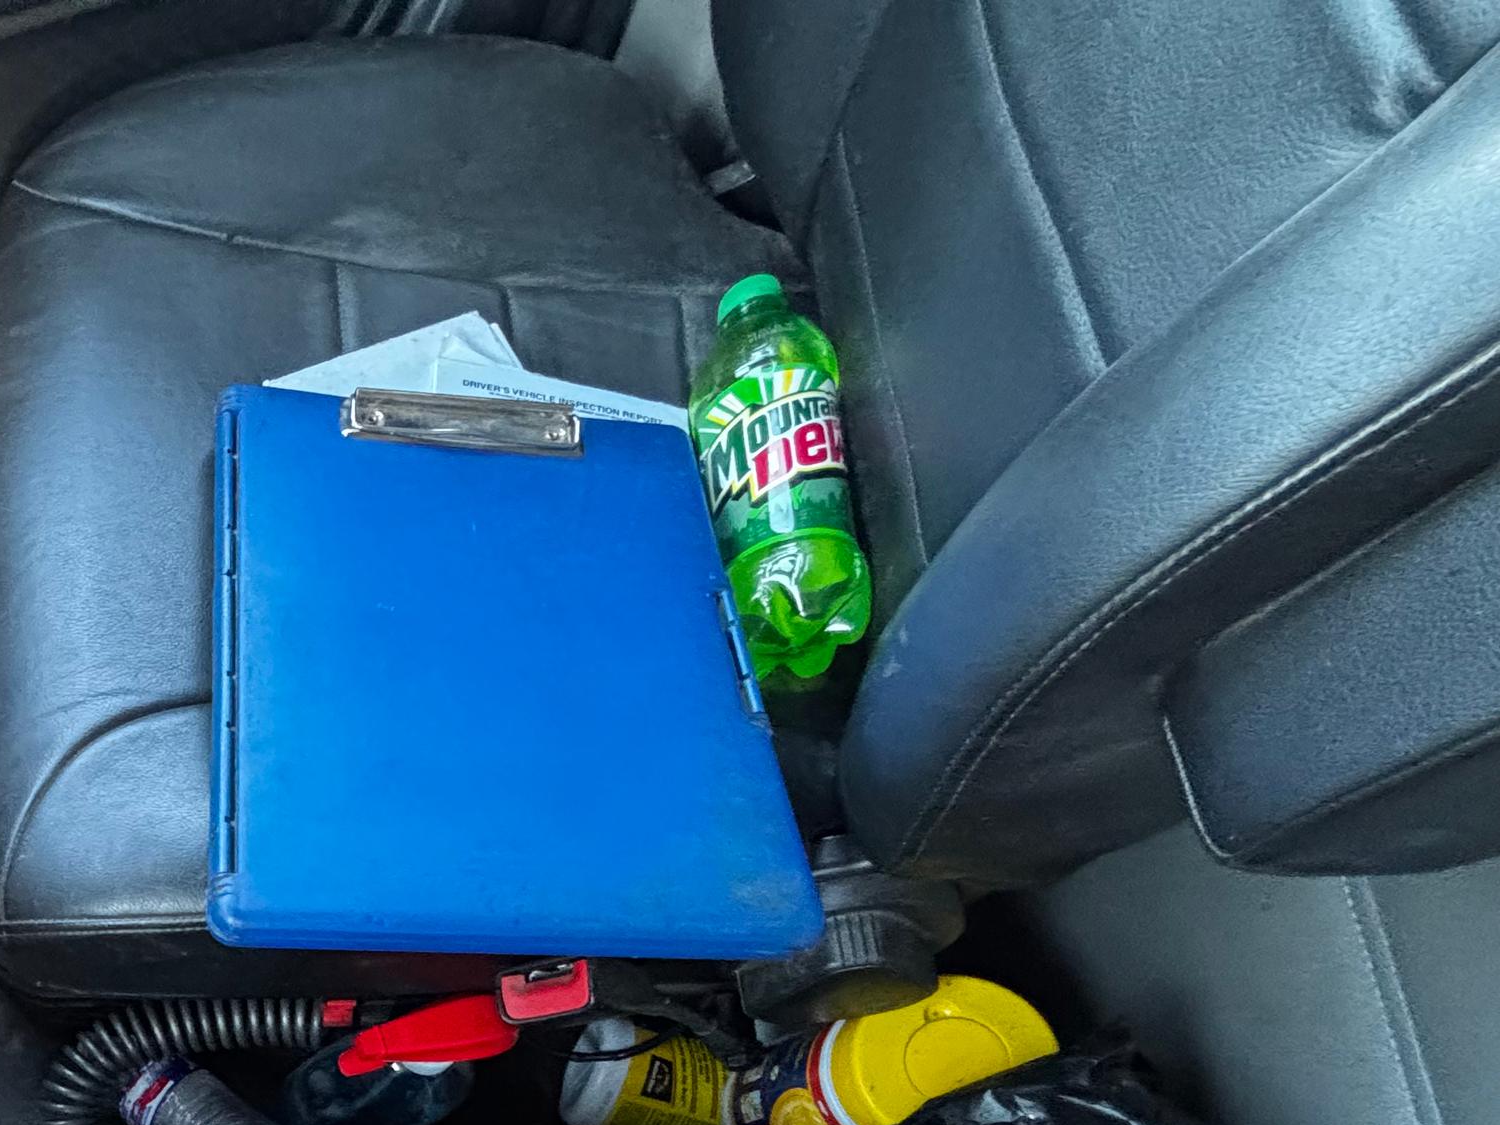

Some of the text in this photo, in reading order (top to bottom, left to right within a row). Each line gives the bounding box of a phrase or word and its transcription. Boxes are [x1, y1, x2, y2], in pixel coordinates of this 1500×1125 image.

[462, 379, 510, 395] DRIVER'S
[512, 388, 556, 404] VEHICLE
[558, 397, 621, 416] INSPECTION
